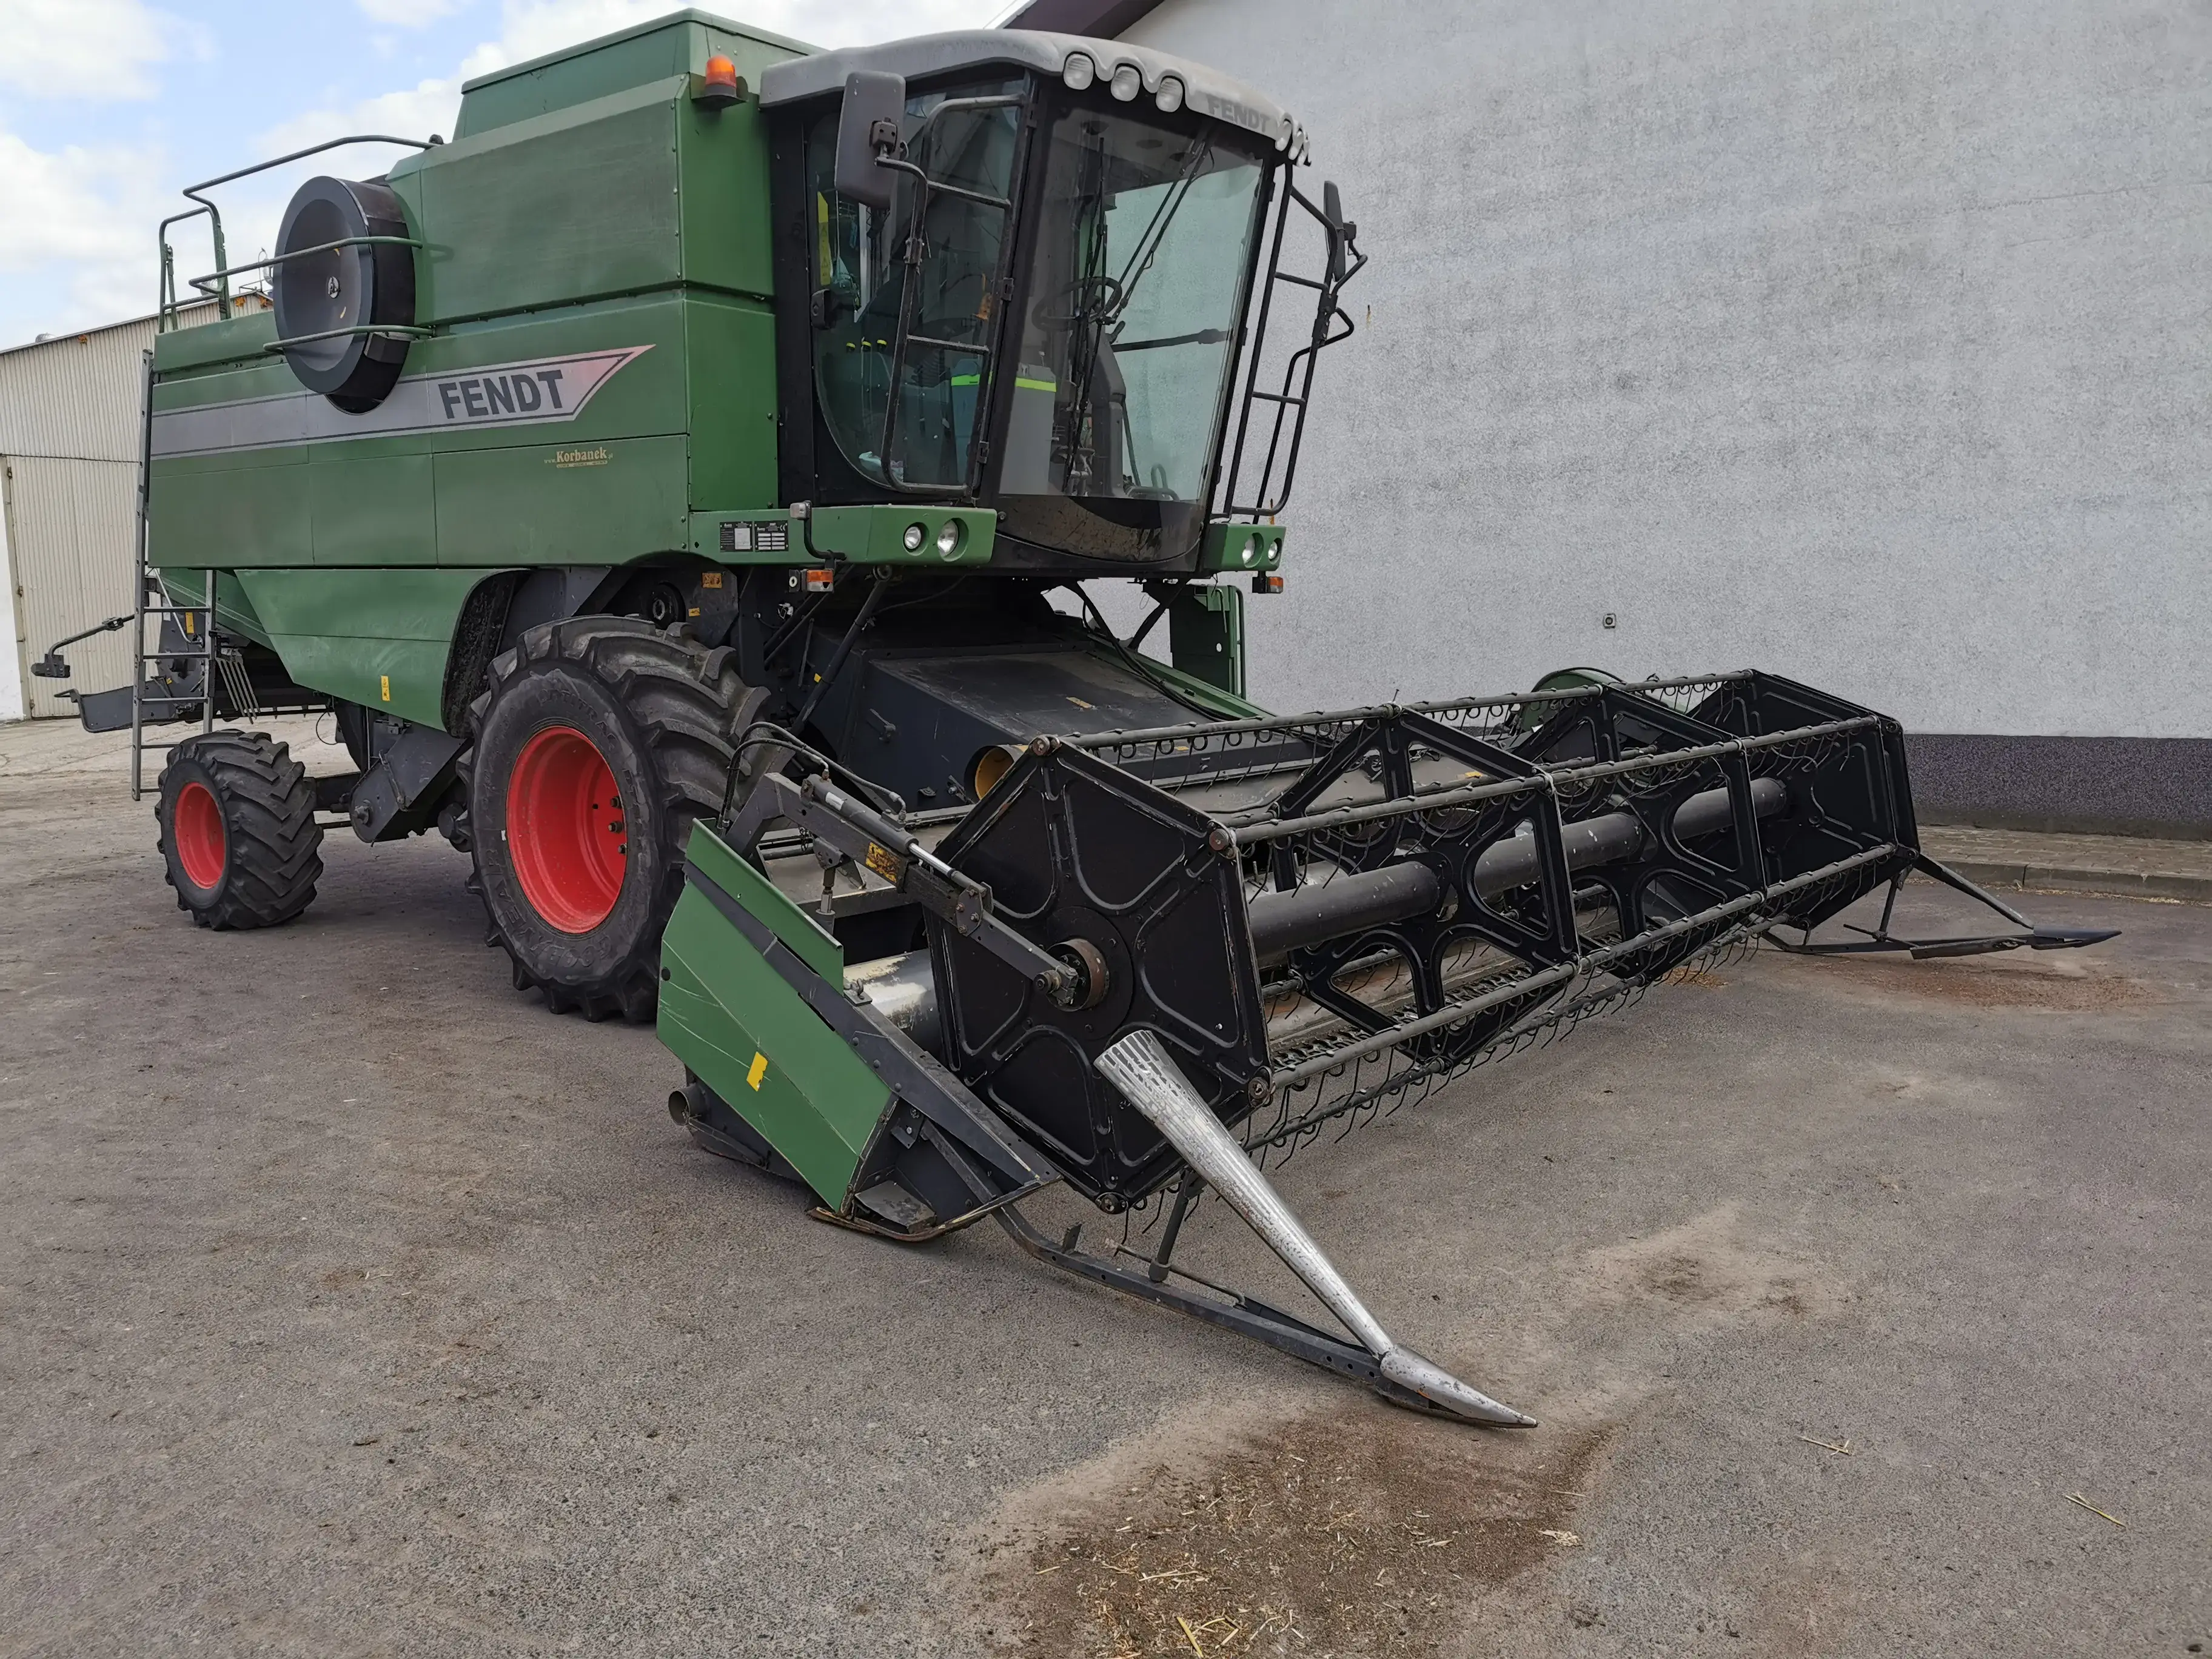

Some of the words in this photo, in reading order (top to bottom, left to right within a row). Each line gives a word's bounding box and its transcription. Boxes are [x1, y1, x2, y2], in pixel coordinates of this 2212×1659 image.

[1206, 95, 1271, 133] FENDT
[438, 370, 563, 419] FENDT
[486, 849, 611, 967] GOODYEAR
